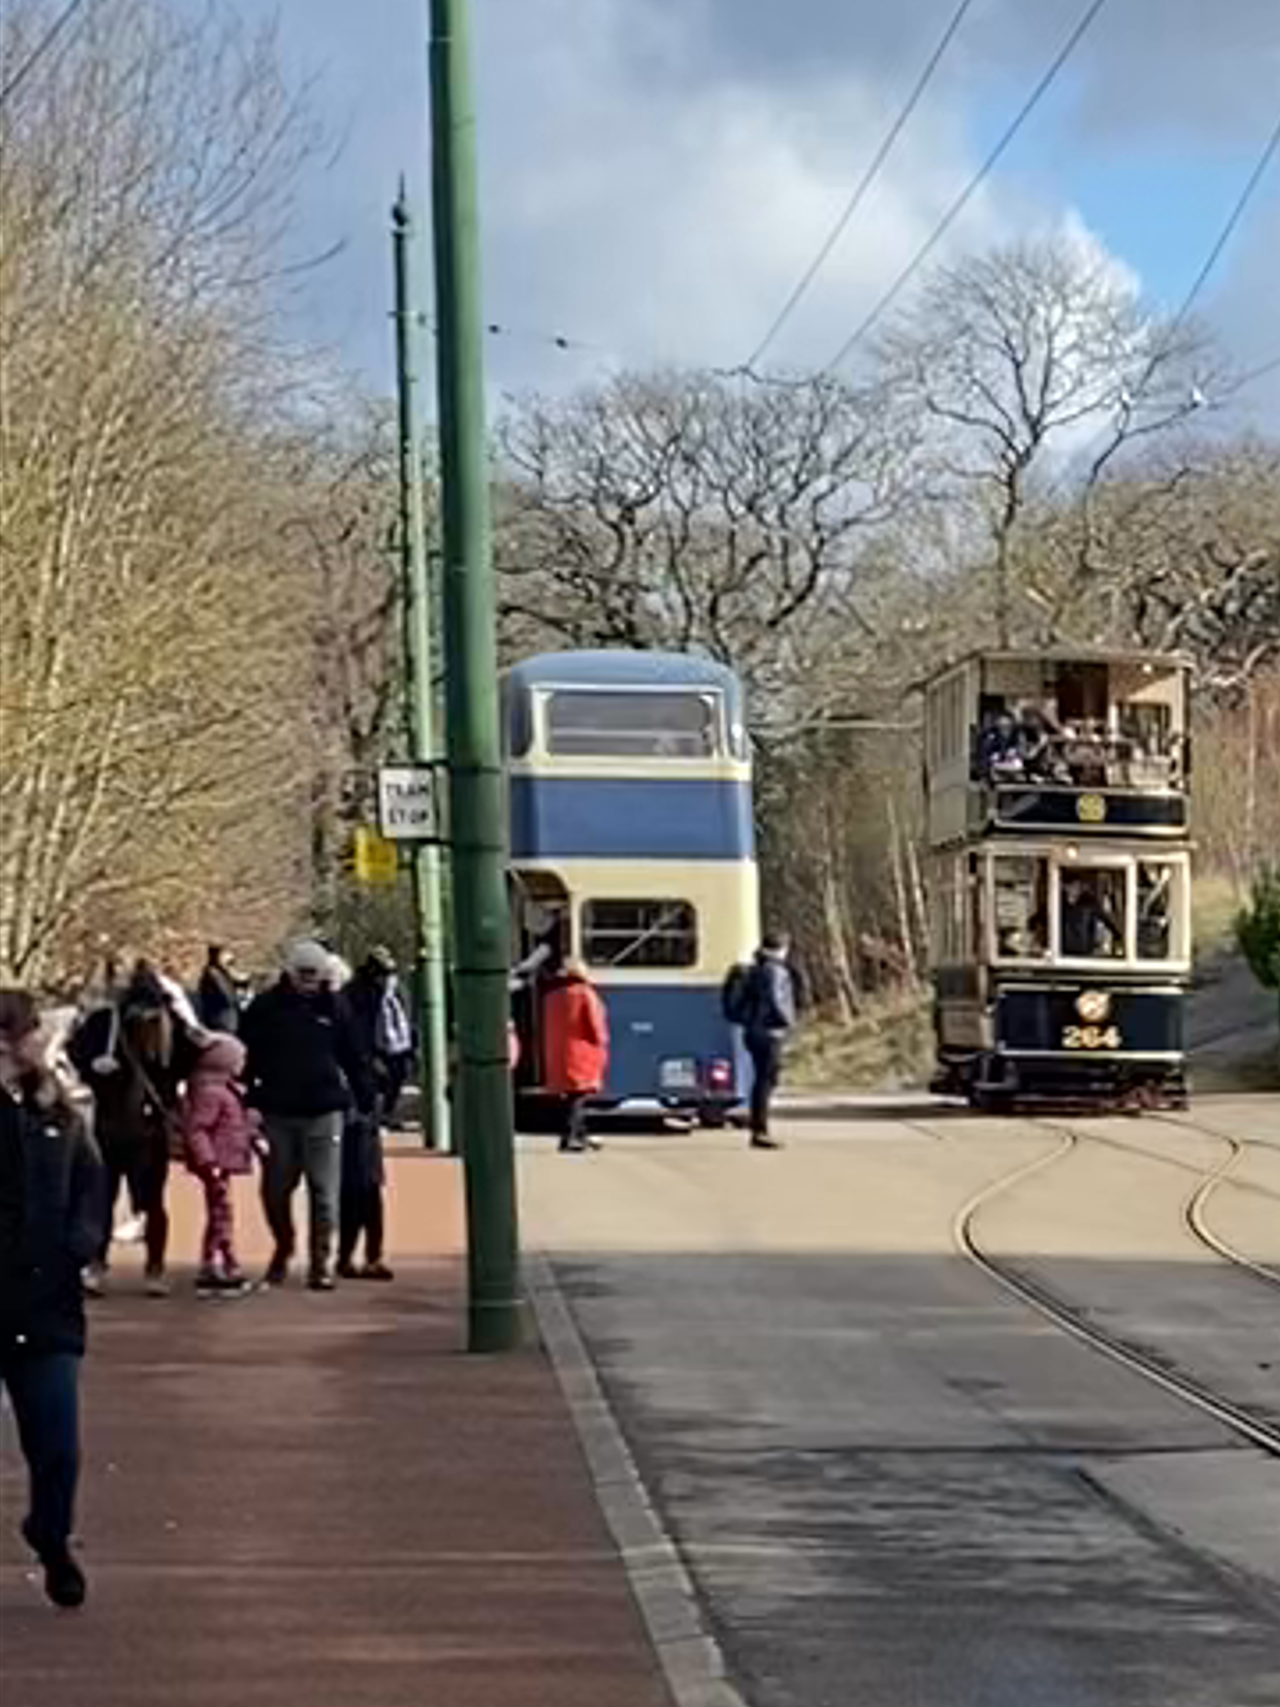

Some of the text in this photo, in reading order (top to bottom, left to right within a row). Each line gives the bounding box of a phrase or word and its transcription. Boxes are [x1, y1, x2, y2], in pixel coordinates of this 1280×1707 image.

[385, 782, 430, 797] TRAM
[388, 808, 430, 825] STOP
[1062, 1024, 1121, 1049] 264
